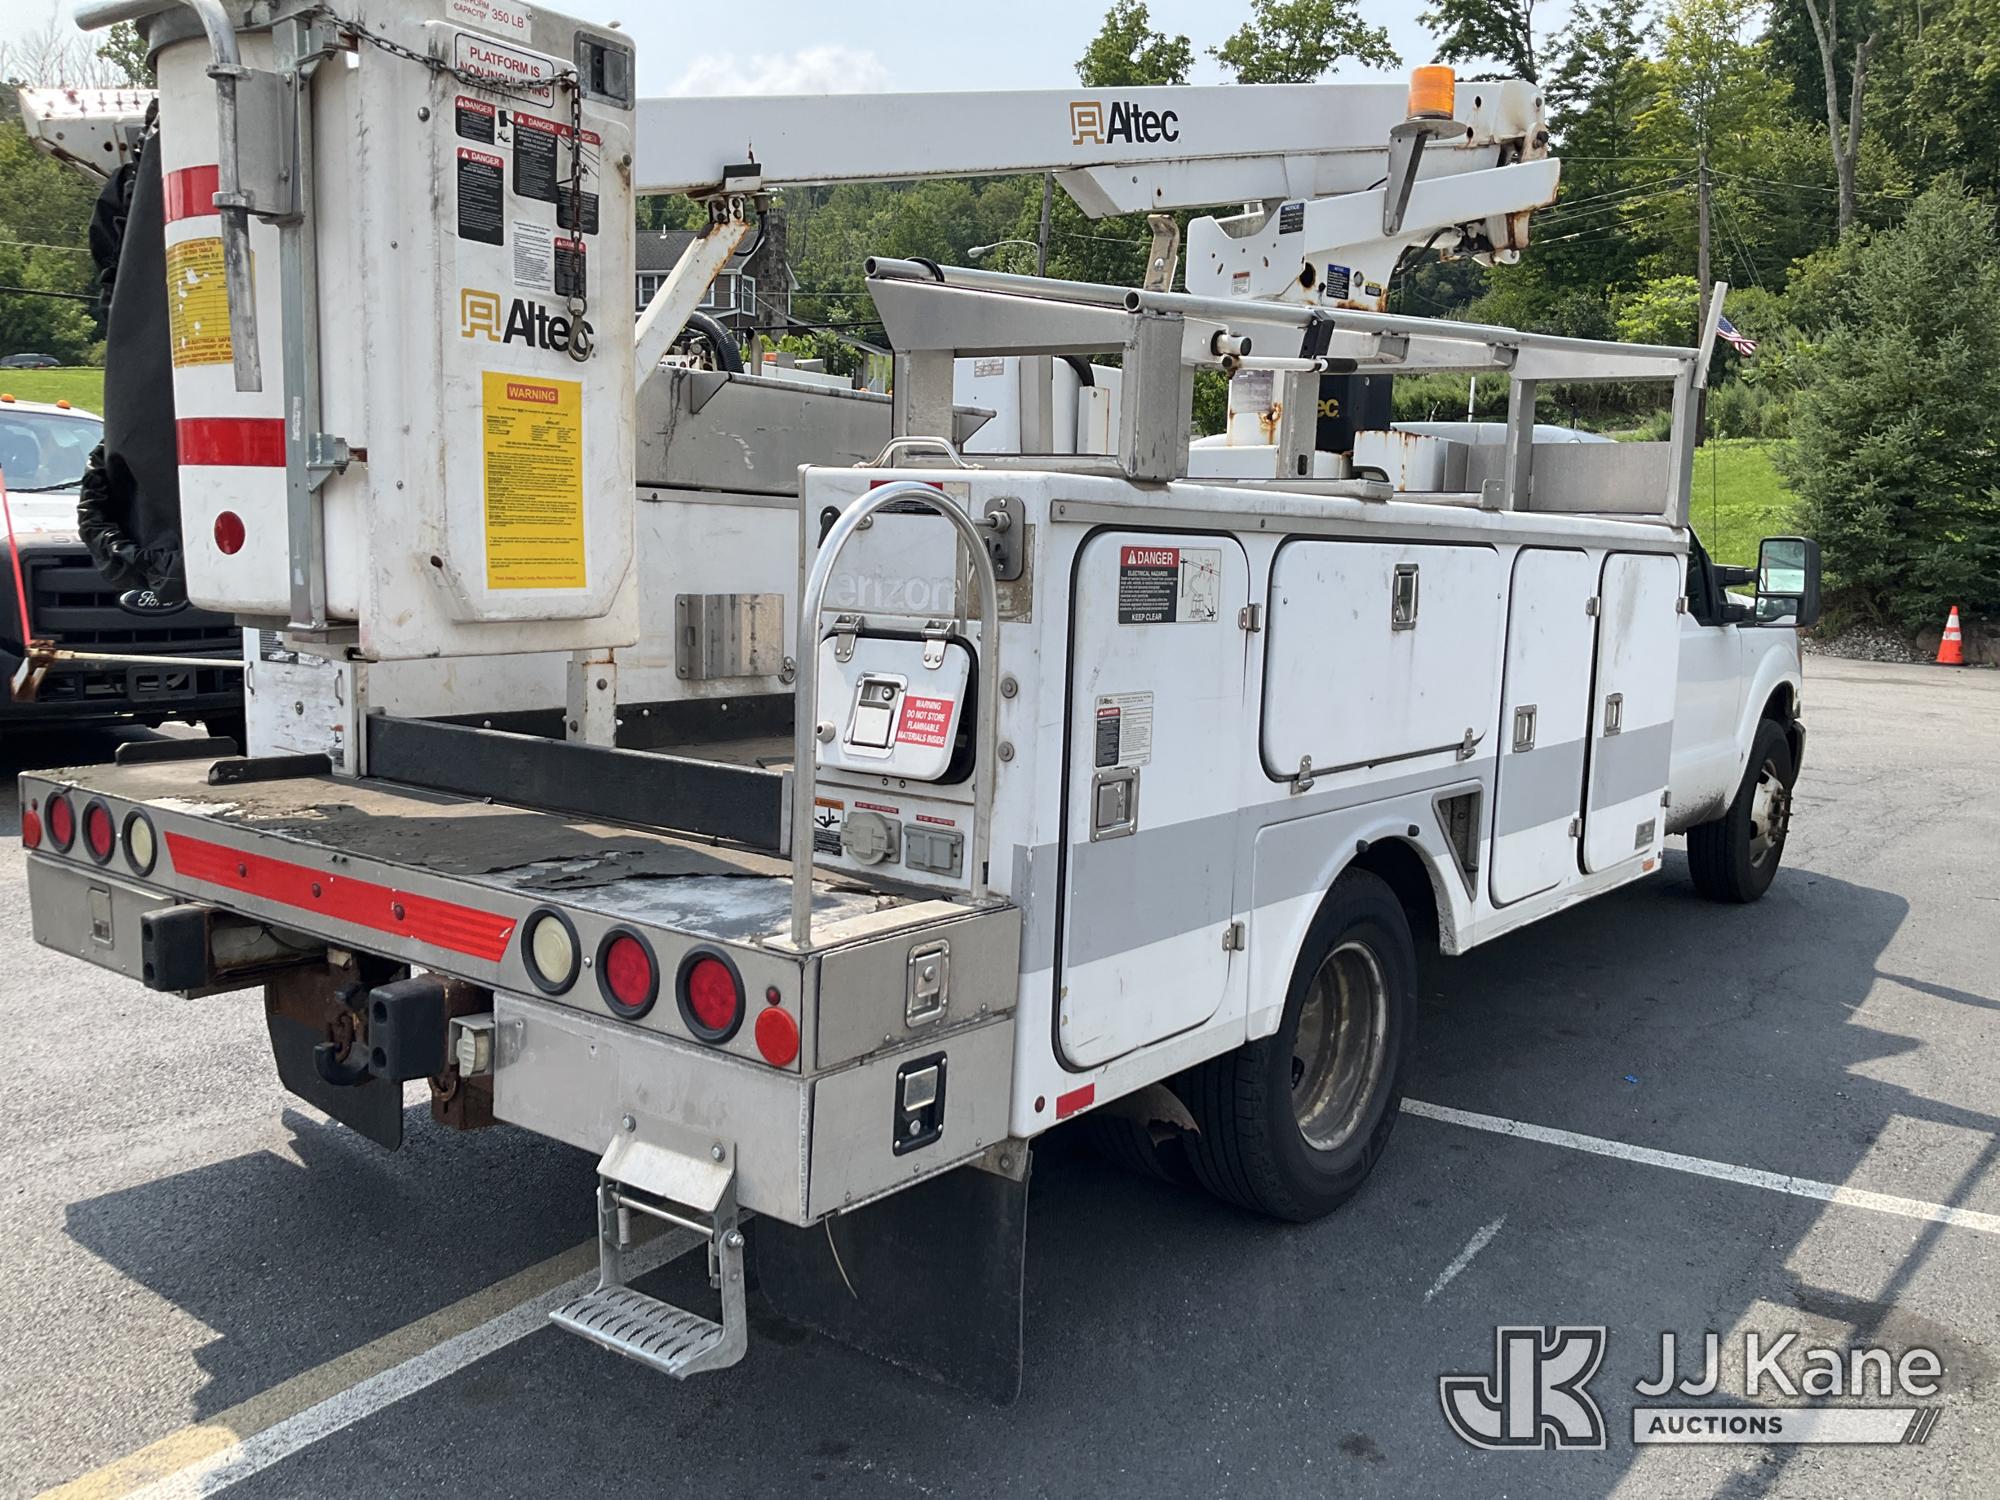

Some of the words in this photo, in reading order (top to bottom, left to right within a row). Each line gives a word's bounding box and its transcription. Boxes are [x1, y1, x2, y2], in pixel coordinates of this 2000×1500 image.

[491, 8, 509, 23] 350
[511, 15, 524, 28] LB
[470, 46, 529, 75] PLATFORM
[530, 65, 541, 78] IS
[464, 100, 493, 115] DANGER
[528, 117, 555, 132] DANGER
[1106, 101, 1180, 144] Altec
[471, 151, 500, 167] DANGER
[508, 386, 556, 402] WARNING
[1137, 551, 1173, 565] DANGER
[836, 572, 954, 611] erizon
[1131, 612, 1145, 621] KEEP
[1145, 612, 1162, 621] CLEAR
[916, 700, 942, 711] WARNING
[906, 709, 916, 718] DO
[915, 711, 928, 720] NOT
[927, 712, 946, 722] STORE
[907, 721, 940, 733] FLAMMABLE
[898, 731, 927, 742] MATERIALS
[926, 734, 945, 745] INSIDE
